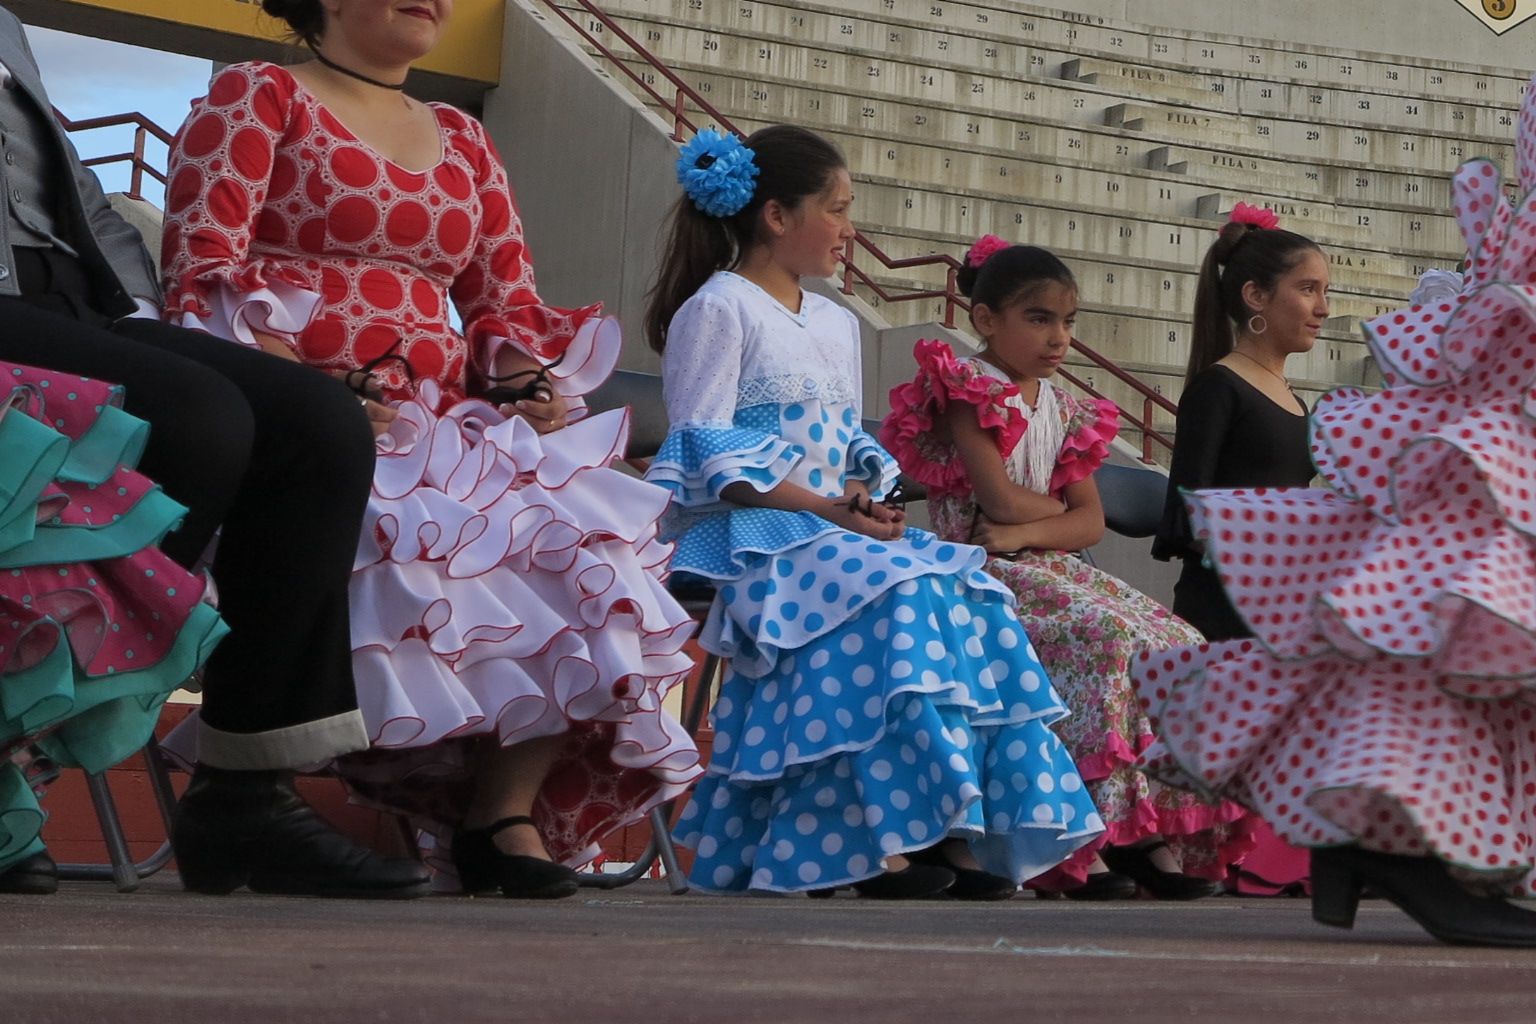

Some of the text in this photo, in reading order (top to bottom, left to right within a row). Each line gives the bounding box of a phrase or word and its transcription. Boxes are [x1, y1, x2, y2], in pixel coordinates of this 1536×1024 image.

[689, 0, 702, 10] 22
[740, 8, 752, 19] 23
[930, 6, 942, 17] 28
[977, 14, 988, 23] 29
[1062, 11, 1104, 25] FILA 9
[590, 21, 602, 33] 18
[841, 25, 853, 36] 25
[1022, 22, 1034, 31] 30
[648, 30, 660, 42] 19
[890, 32, 901, 43] 26
[1066, 30, 1078, 40] 31
[703, 40, 717, 52] 20
[938, 41, 948, 50] 27
[1110, 38, 1123, 47] 32
[1154, 43, 1168, 53] 33
[759, 49, 771, 60] 21
[984, 48, 997, 58] 28
[1202, 49, 1214, 59] 34
[814, 58, 827, 69] 22
[1030, 55, 1044, 65] 29
[1249, 55, 1261, 64] 35
[1295, 60, 1307, 70] 36
[867, 66, 880, 77] 23
[1122, 68, 1151, 80] FILA
[1340, 65, 1352, 75] 37
[1386, 70, 1398, 81] 38
[920, 75, 934, 86] 24
[1430, 76, 1442, 85] 39
[1476, 81, 1487, 91] 40
[699, 82, 711, 92] 19
[972, 83, 985, 94] 25
[1211, 83, 1225, 94] 30
[753, 90, 767, 102] 20
[1023, 91, 1036, 101] 26
[1261, 89, 1272, 98] 31
[1309, 94, 1322, 104] 32
[1073, 99, 1085, 108] 27
[1358, 100, 1370, 110] 33
[862, 107, 875, 118] 22
[1406, 105, 1418, 115] 34
[1167, 112, 1211, 127] FILA 7
[1453, 111, 1464, 121] 35
[1499, 116, 1511, 126] 36
[967, 123, 980, 134] 24
[1257, 126, 1270, 136] 28
[1018, 131, 1030, 142] 25
[1306, 131, 1319, 141] 29
[1354, 136, 1367, 146] 30
[1068, 138, 1081, 149] 26
[1403, 141, 1415, 152] 31
[887, 150, 895, 161] 6
[1116, 145, 1129, 156] 27
[1450, 147, 1462, 157] 32
[944, 157, 951, 169] 7
[1213, 155, 1257, 170] FILA 6
[1000, 166, 1007, 177] 8
[1055, 174, 1062, 184] 9
[1356, 178, 1369, 187] 29
[1106, 181, 1119, 192] 10
[1406, 183, 1418, 193] 30
[1159, 189, 1171, 200] 11
[905, 198, 912, 209] 6
[961, 206, 967, 217] 7
[1303, 207, 1309, 217] 5
[1015, 213, 1022, 224] 8
[1357, 215, 1369, 226] 12
[1069, 220, 1076, 231] 9
[1410, 221, 1421, 231] 13
[1119, 227, 1131, 238] 10
[1169, 234, 1181, 245] 11
[1330, 254, 1366, 267] ILA 4
[1107, 273, 1113, 284] 8
[1164, 280, 1171, 291] 9
[872, 296, 879, 307] 3
[1169, 331, 1176, 342] 8
[1330, 349, 1341, 360] 11
